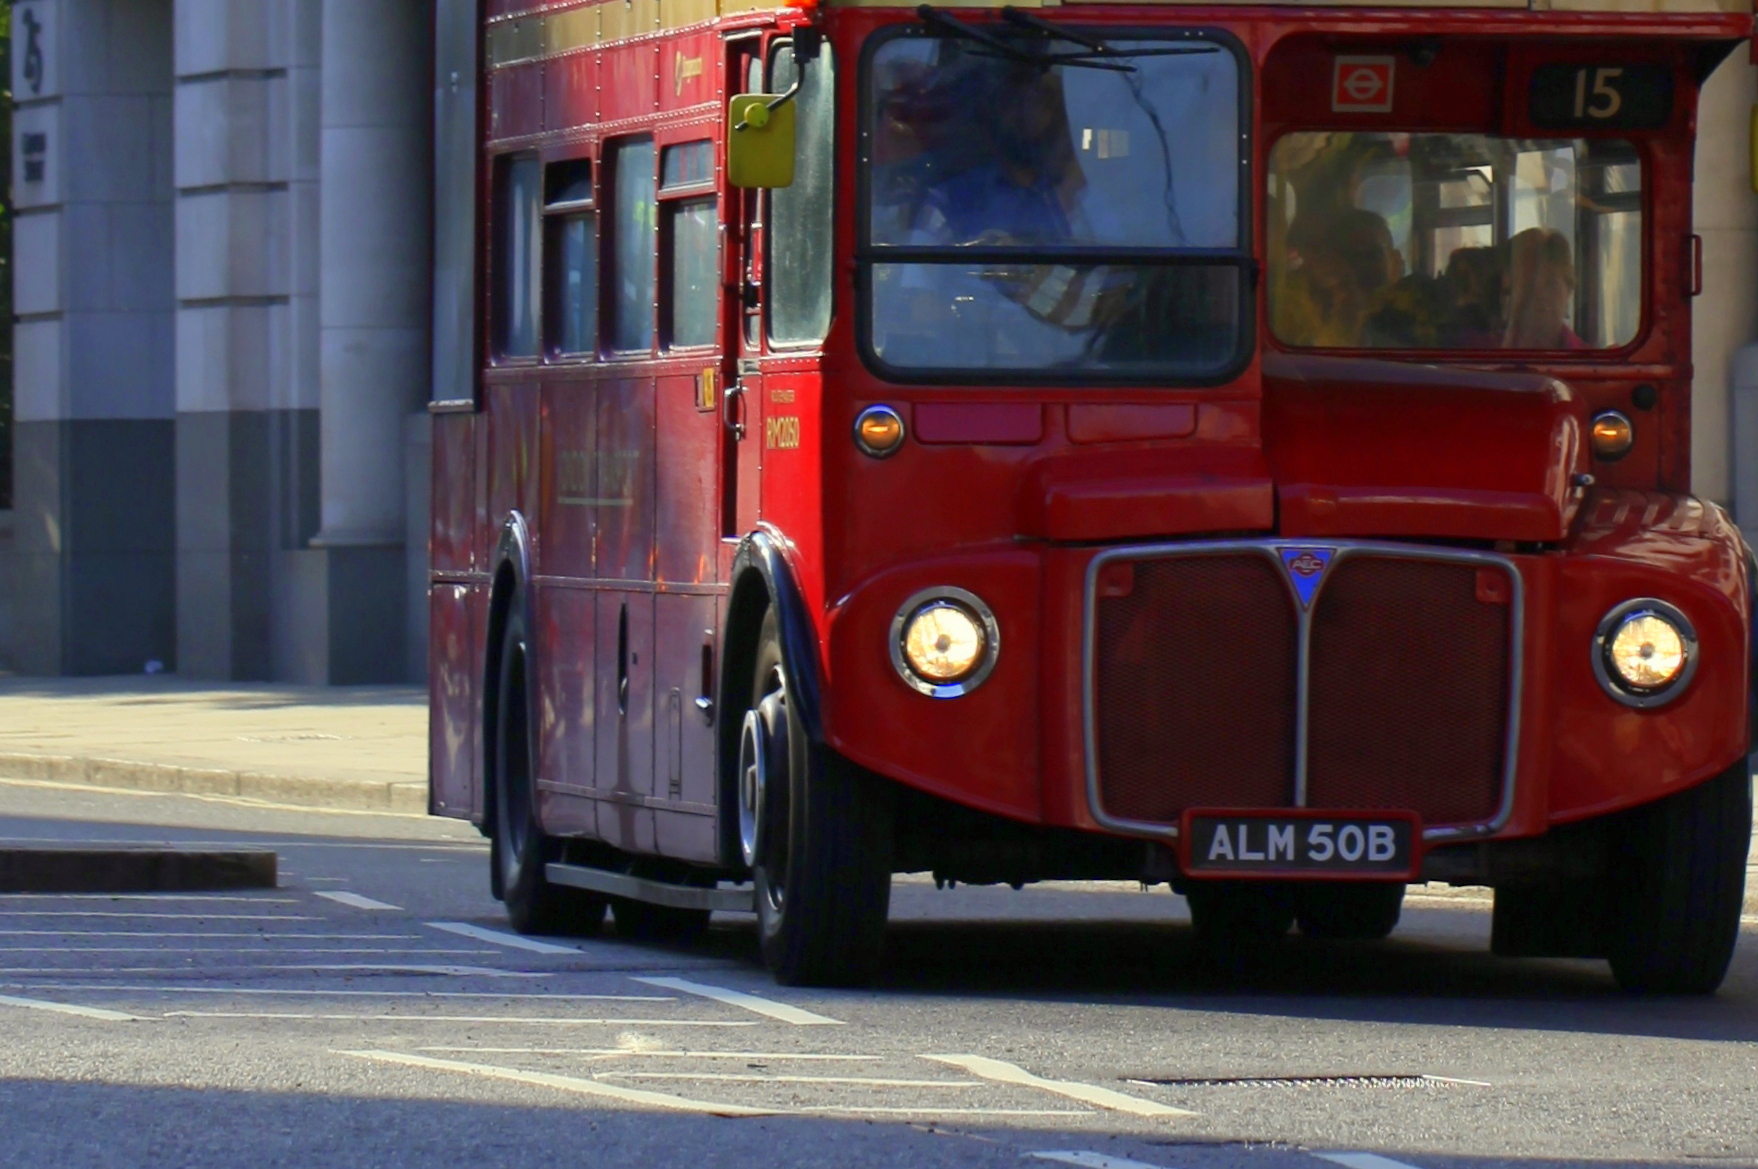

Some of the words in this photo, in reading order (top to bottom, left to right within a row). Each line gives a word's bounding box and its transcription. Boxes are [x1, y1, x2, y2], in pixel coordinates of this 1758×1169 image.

[1573, 67, 1623, 119] 15
[1292, 558, 1322, 570] AEC
[1207, 823, 1295, 862] ALM
[1307, 824, 1397, 862] 50B
